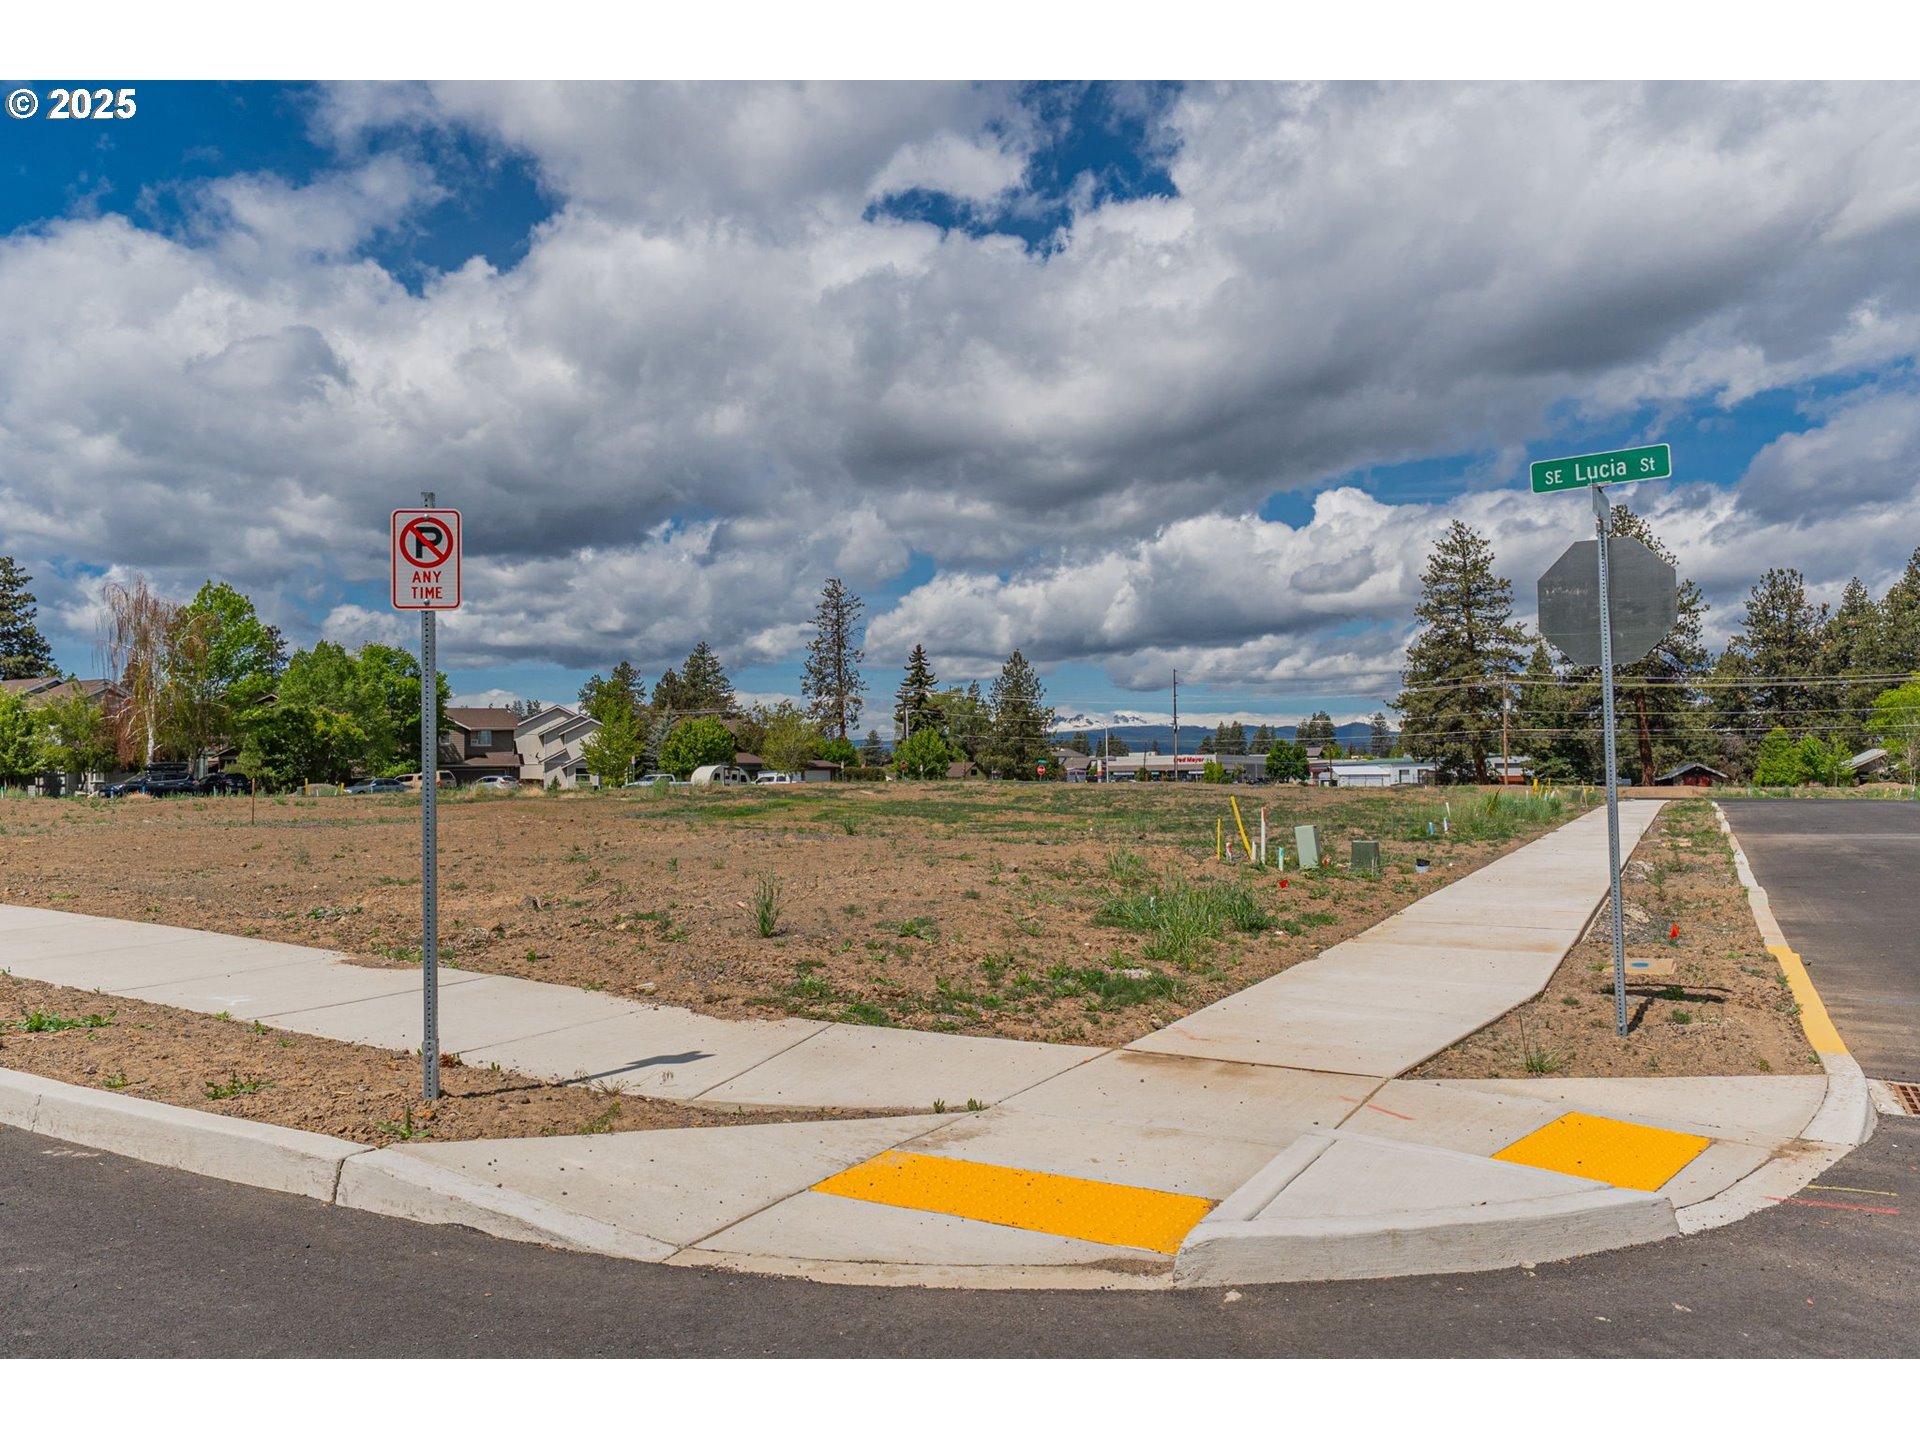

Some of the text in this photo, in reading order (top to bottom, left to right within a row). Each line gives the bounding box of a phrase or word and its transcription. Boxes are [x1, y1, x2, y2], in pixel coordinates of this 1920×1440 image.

[1545, 457, 1655, 485] SE Lucia St
[412, 570, 442, 583] ANY
[411, 586, 443, 599] TIME
